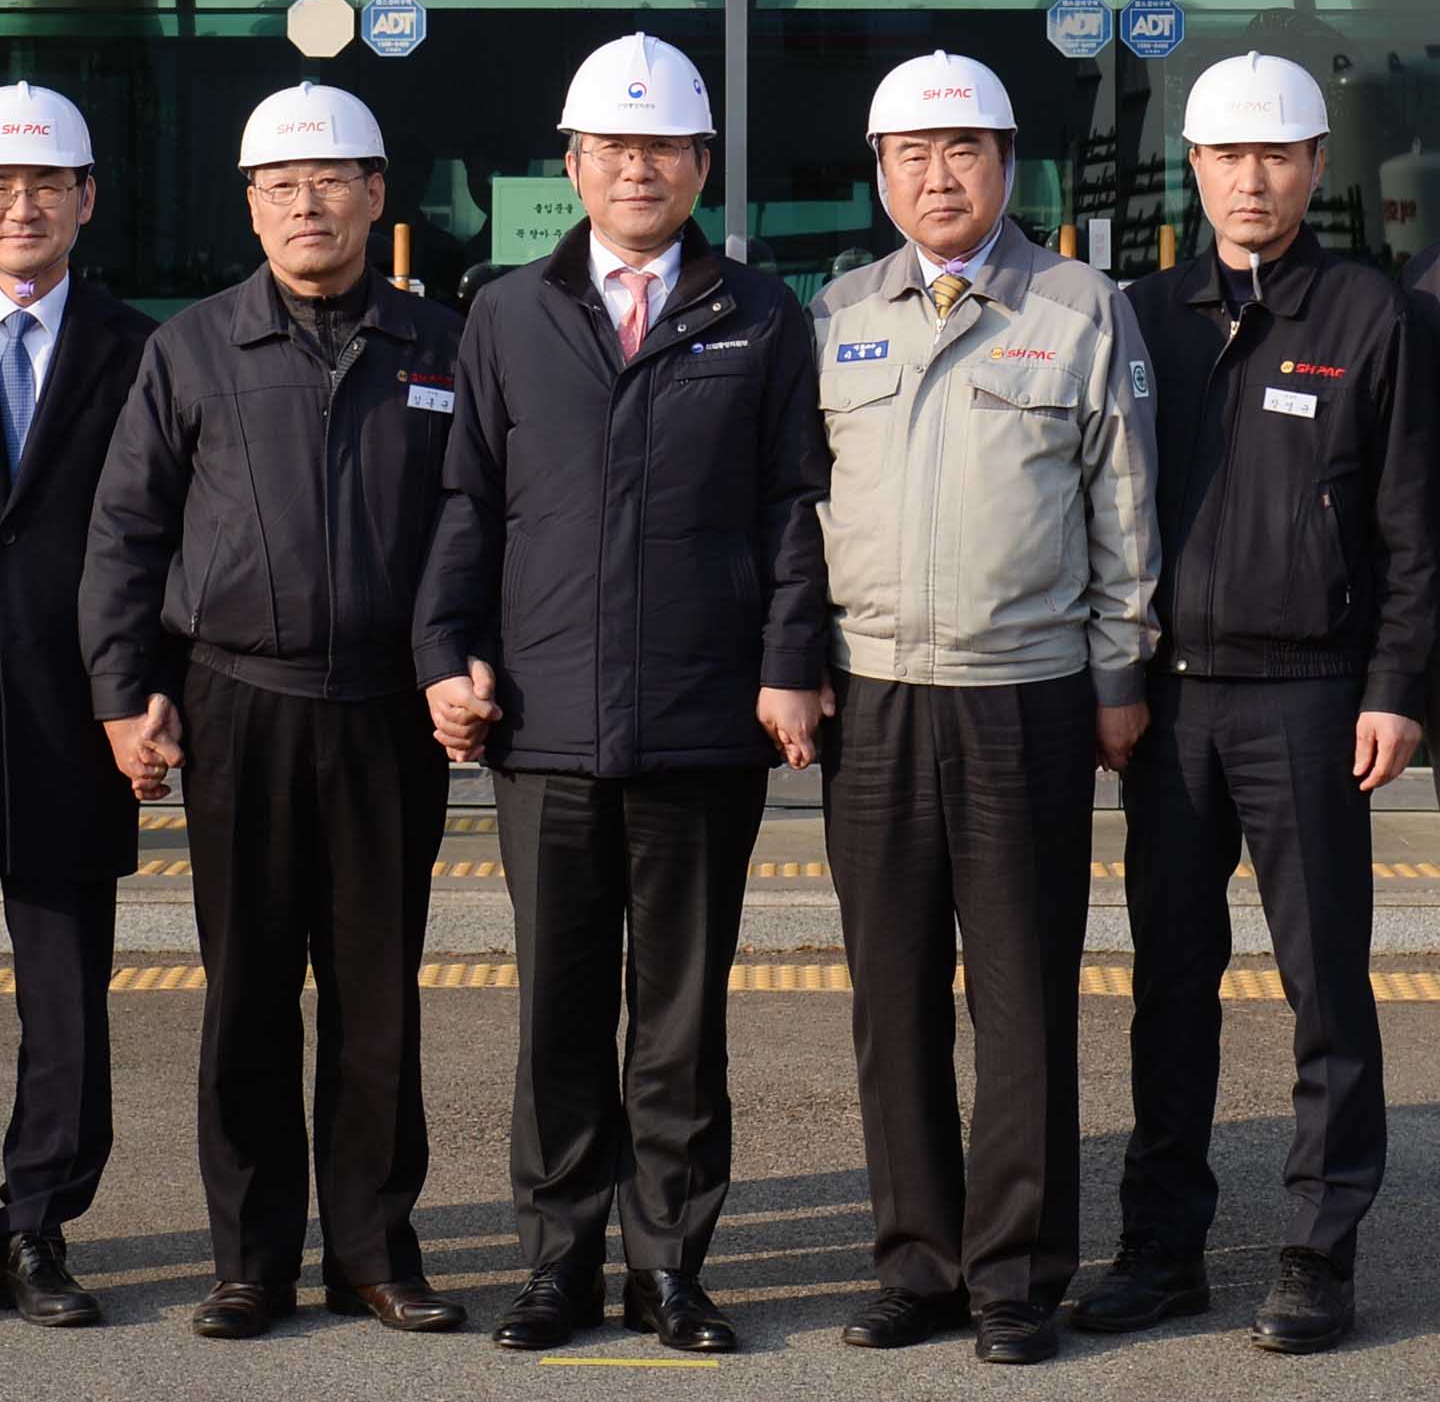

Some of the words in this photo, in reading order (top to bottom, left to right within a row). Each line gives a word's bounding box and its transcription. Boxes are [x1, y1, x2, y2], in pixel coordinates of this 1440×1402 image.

[372, 11, 416, 35] ADT
[1131, 13, 1175, 37] ADT
[922, 88, 942, 100] SH
[944, 87, 973, 99] PAC
[1, 123, 21, 135] SH
[23, 123, 51, 135] PAC
[275, 122, 296, 134] SH
[297, 120, 327, 133] PAC
[1007, 349, 1026, 359] SH
[1027, 350, 1056, 361] PAC
